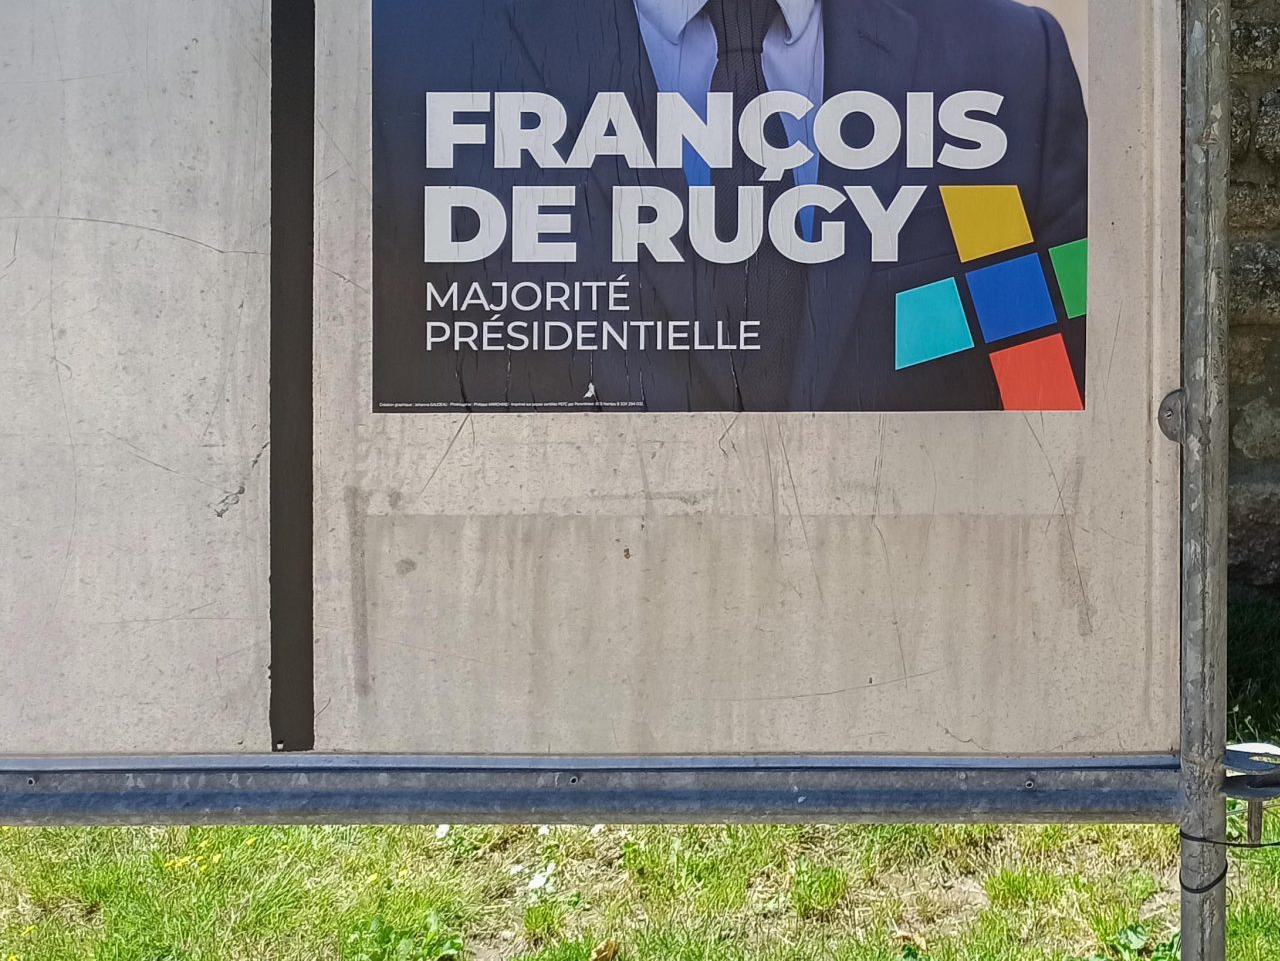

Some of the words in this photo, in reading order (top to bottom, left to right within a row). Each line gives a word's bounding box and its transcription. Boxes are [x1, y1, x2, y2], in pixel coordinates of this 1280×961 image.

[425, 90, 1008, 181] FRANÇOIS
[424, 185, 577, 263] DE
[612, 185, 927, 263] RUGY
[425, 274, 630, 312] MAJORITÉ
[425, 313, 761, 351] PRÉSIDENTIELLE
